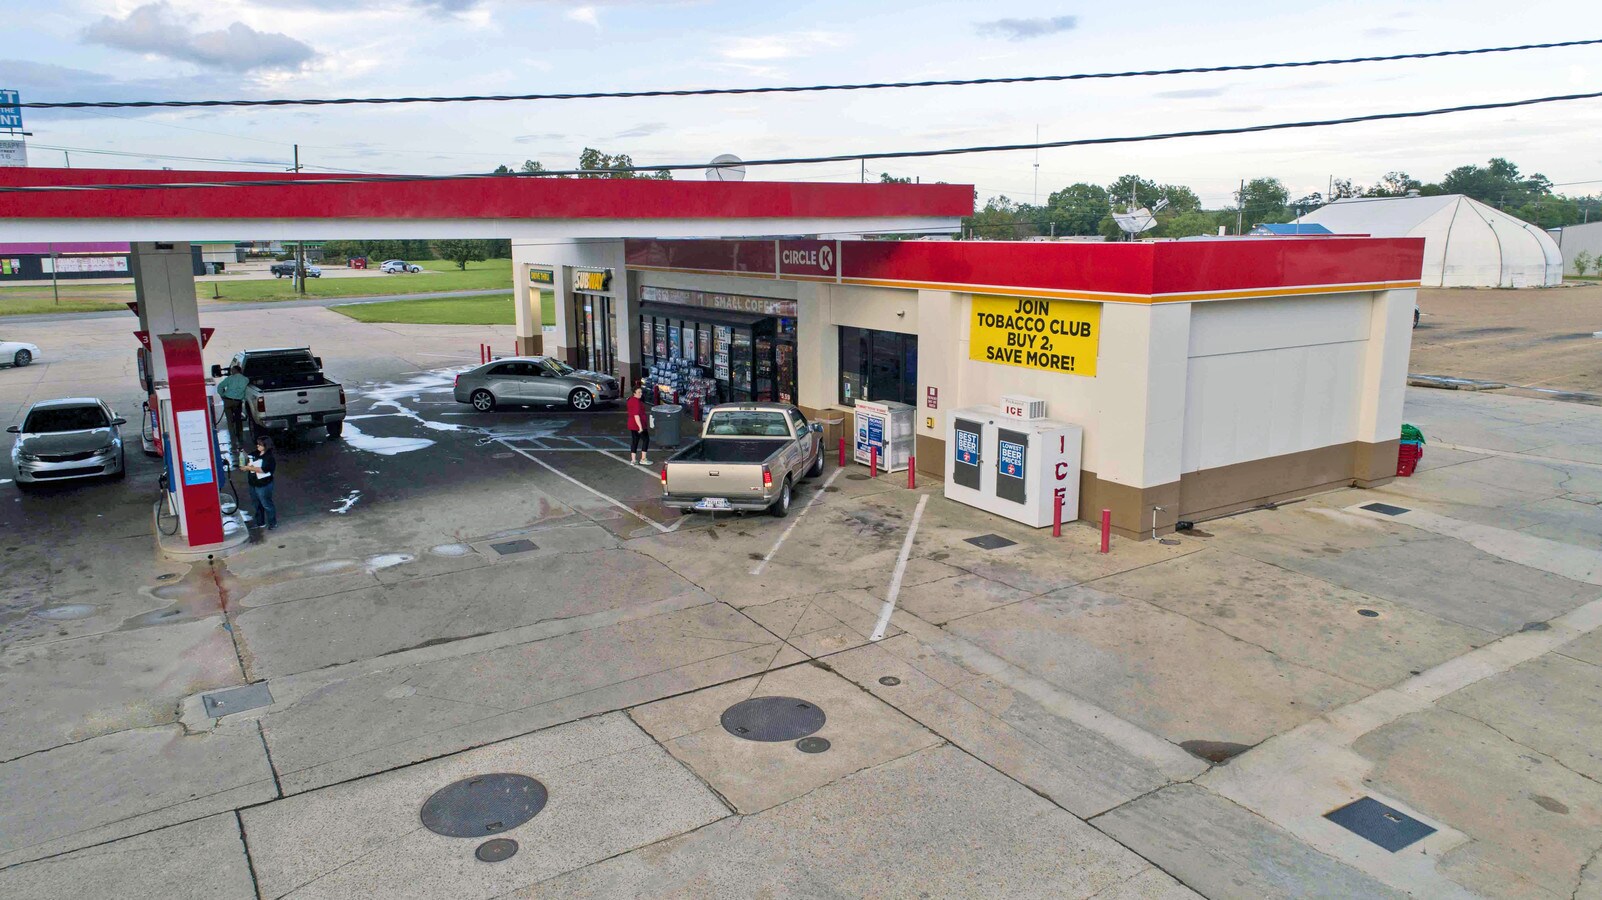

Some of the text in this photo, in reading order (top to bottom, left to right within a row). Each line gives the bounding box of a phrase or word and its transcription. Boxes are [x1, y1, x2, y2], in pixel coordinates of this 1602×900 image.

[783, 248, 832, 269] CIRCLE K
[575, 271, 606, 290] SUBWAY
[714, 296, 742, 310] SMALL
[1015, 299, 1049, 316] JOIN
[977, 312, 1091, 337] TOBACCO CLUB
[1007, 332, 1053, 351] BUY 2,
[986, 346, 1075, 371] SAVE MORE!
[1006, 406, 1023, 416] ICE
[958, 432, 976, 442] BEST
[958, 440, 976, 450] BEER
[1002, 443, 1021, 451] LOWEST
[1002, 448, 1021, 460] BEER
[1002, 458, 1021, 466] PRICES
